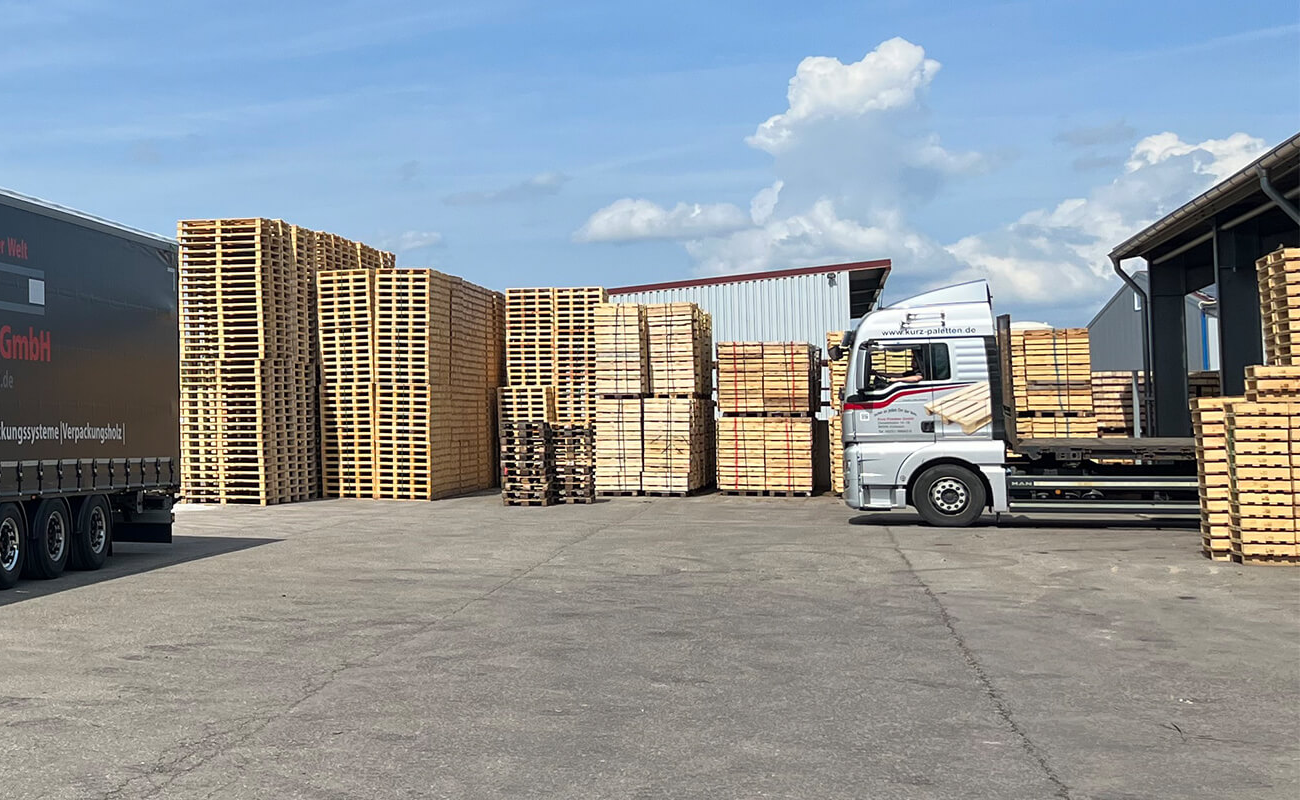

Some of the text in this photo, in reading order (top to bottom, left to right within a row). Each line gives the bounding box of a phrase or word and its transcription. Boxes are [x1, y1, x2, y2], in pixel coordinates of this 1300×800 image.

[7, 237, 28, 260] Welt
[881, 326, 977, 337] www.kurz-paletten.de
[0, 325, 51, 362] GmbH
